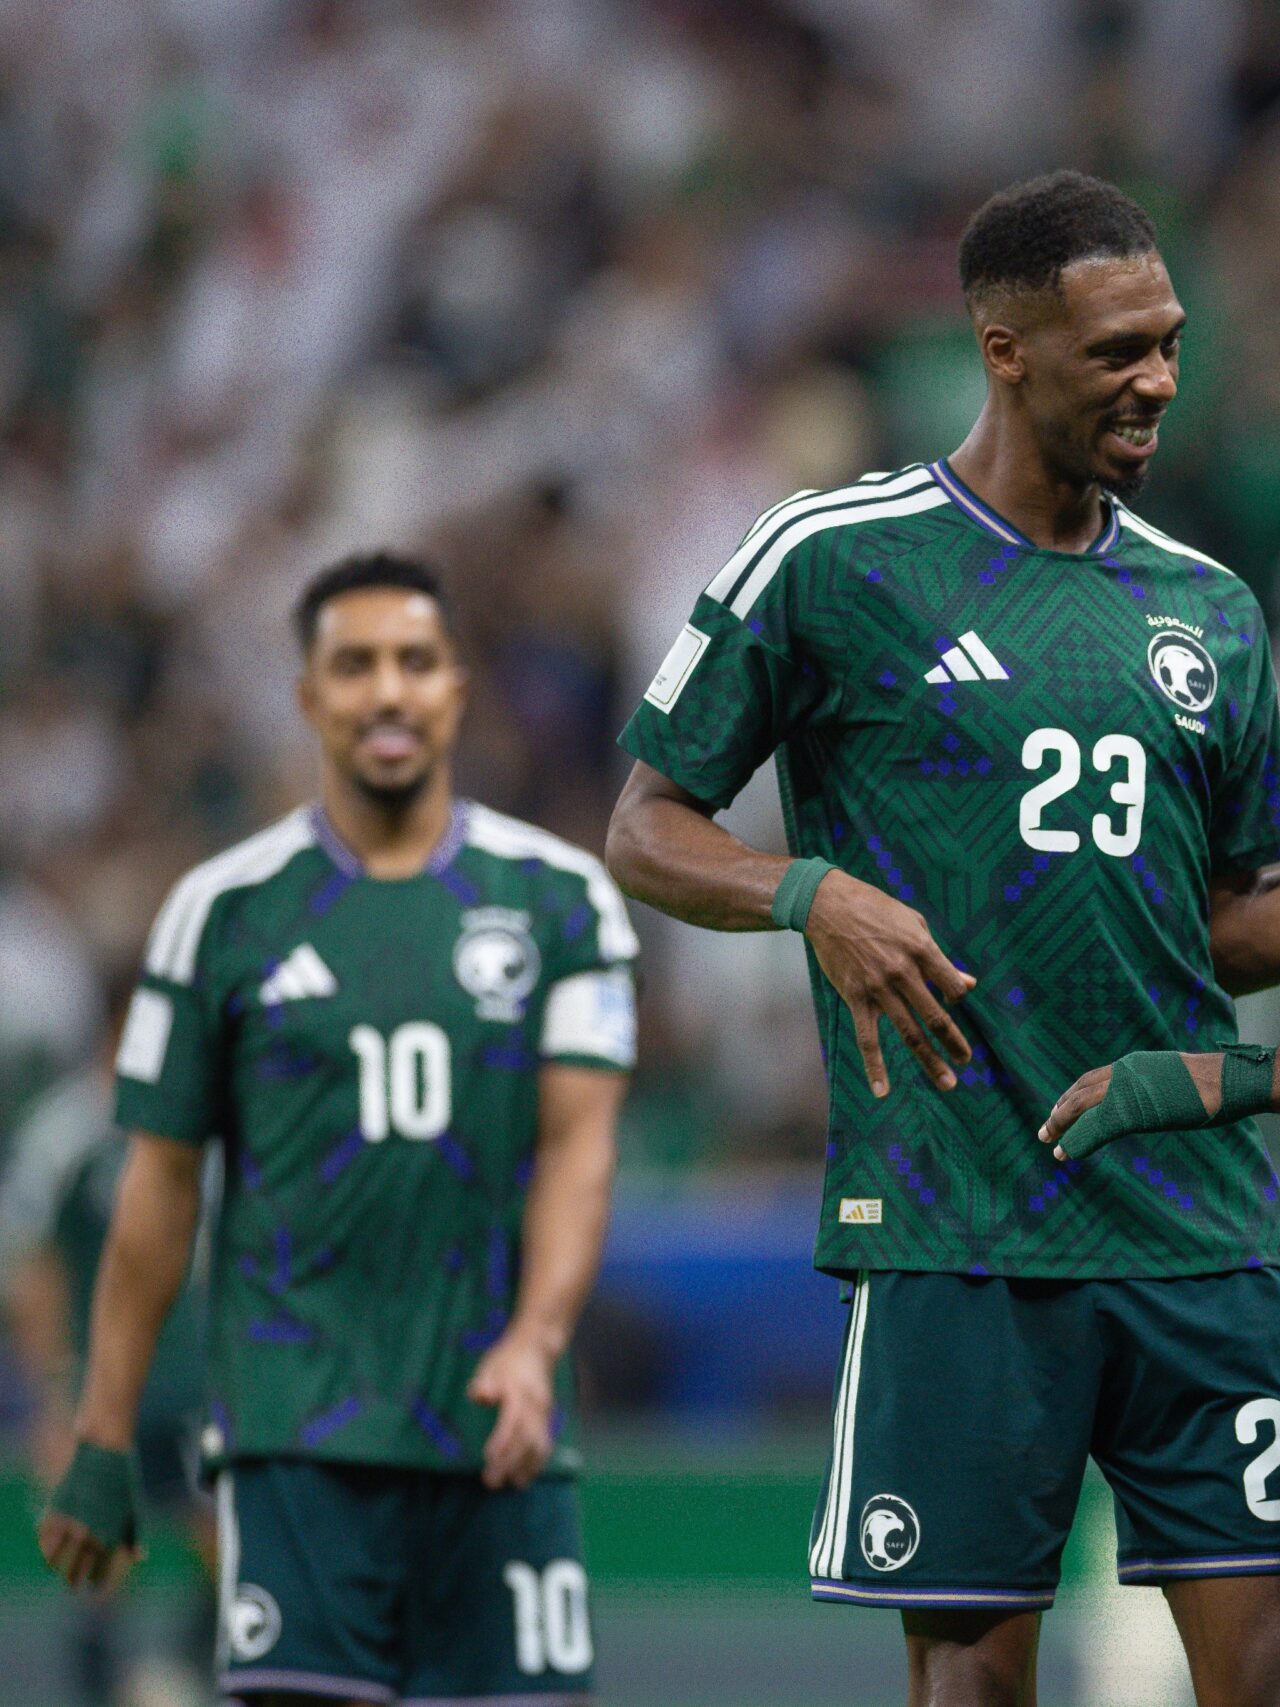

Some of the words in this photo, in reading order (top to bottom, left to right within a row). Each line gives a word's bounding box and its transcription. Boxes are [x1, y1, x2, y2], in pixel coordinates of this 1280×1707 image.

[1175, 713, 1206, 735] SAUDI
[1019, 728, 1146, 857] 23
[348, 1020, 452, 1143] 10
[504, 1557, 594, 1676] 10
